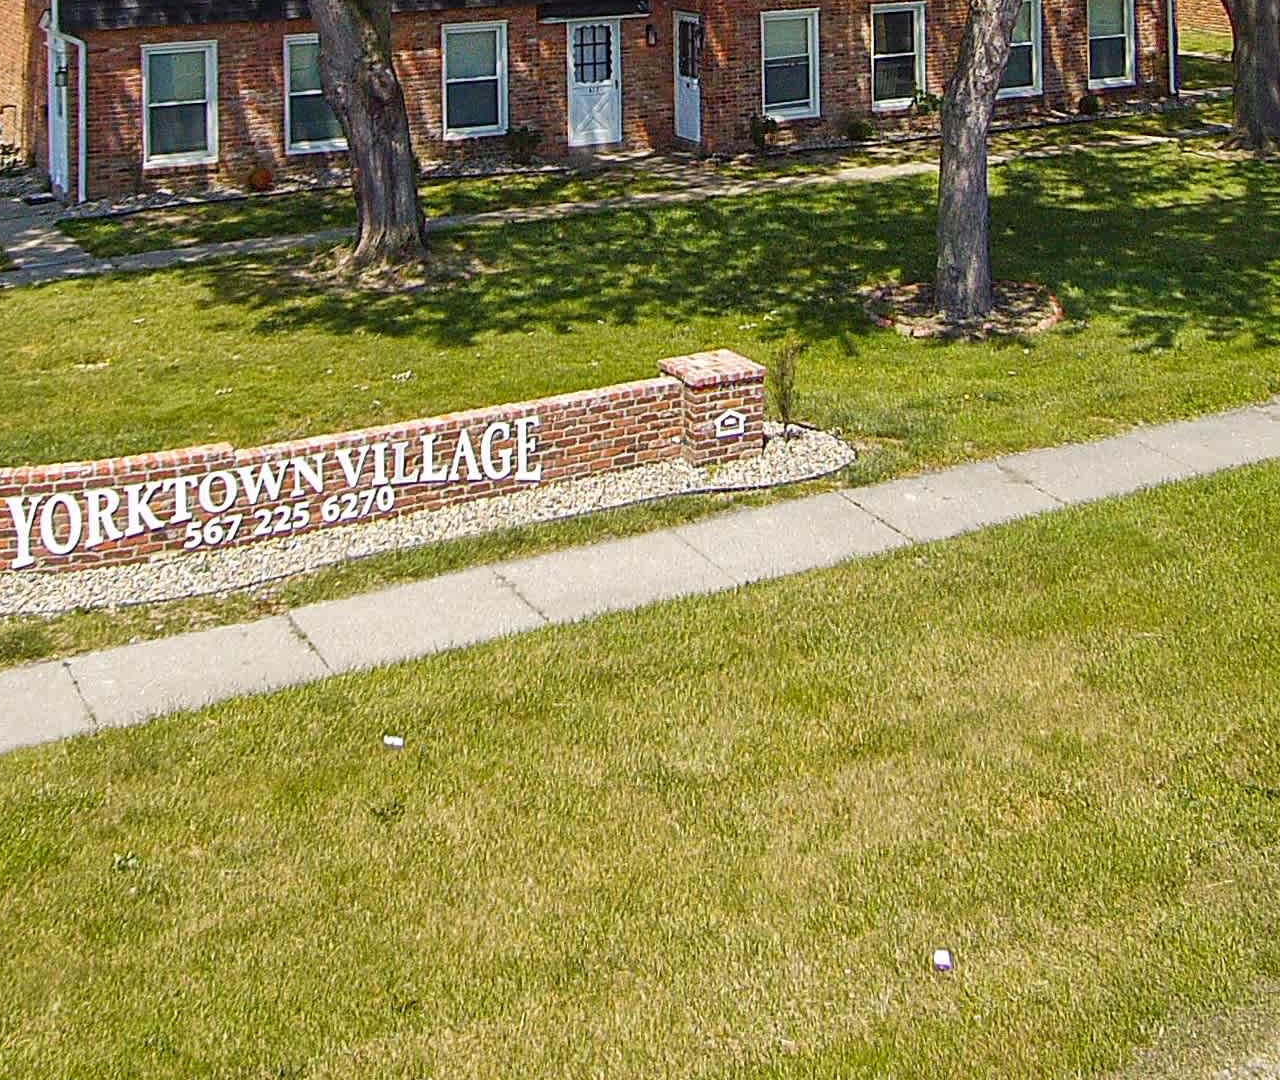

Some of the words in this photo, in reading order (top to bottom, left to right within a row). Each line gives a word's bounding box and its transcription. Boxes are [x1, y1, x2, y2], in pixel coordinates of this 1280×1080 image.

[4, 451, 326, 569] YORKTOWN
[335, 416, 542, 489] VILLAGE
[184, 514, 243, 550] 567
[255, 502, 310, 536] 225
[322, 486, 395, 522] 6270
